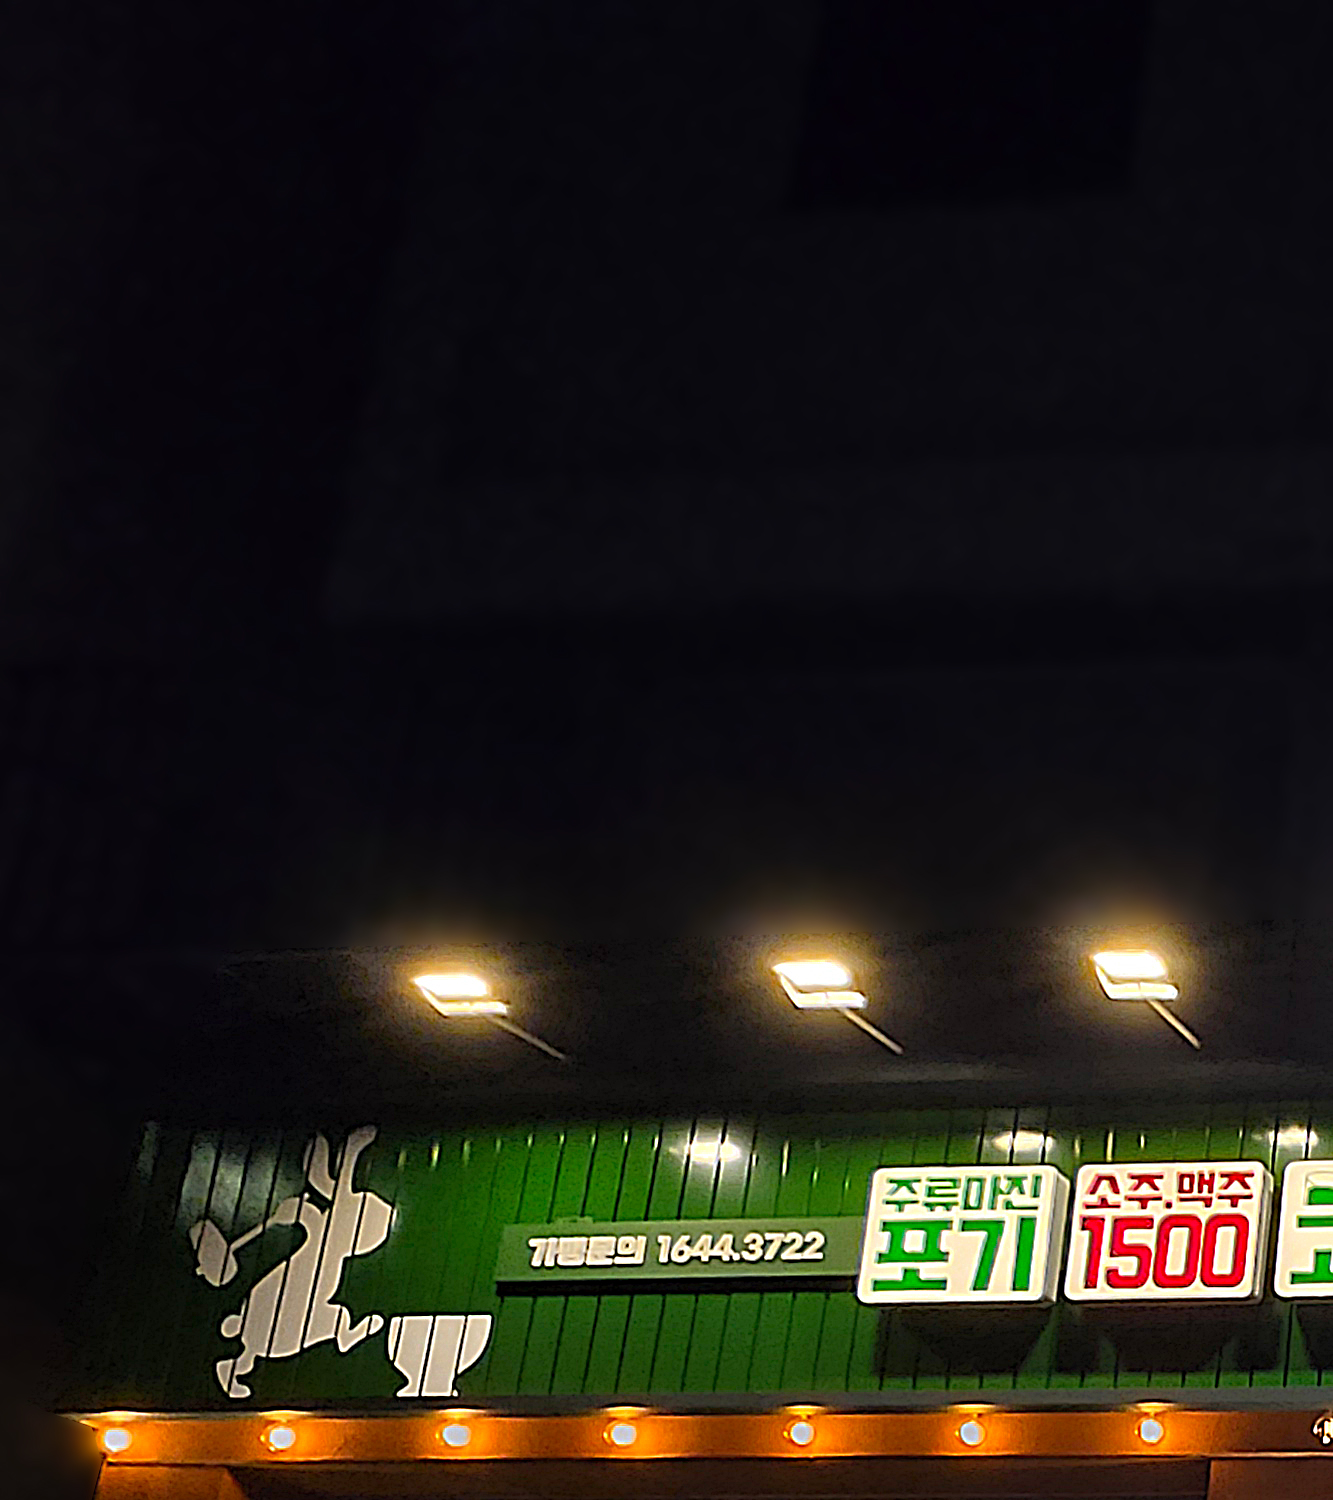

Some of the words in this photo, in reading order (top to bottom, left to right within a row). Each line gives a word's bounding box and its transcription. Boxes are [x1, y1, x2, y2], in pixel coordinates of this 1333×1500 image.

[885, 1174, 1042, 1212] 주류마진
[657, 1231, 825, 1263] 1644.3722
[872, 1217, 1037, 1291] 포기
[1080, 1212, 1250, 1289] 1500
